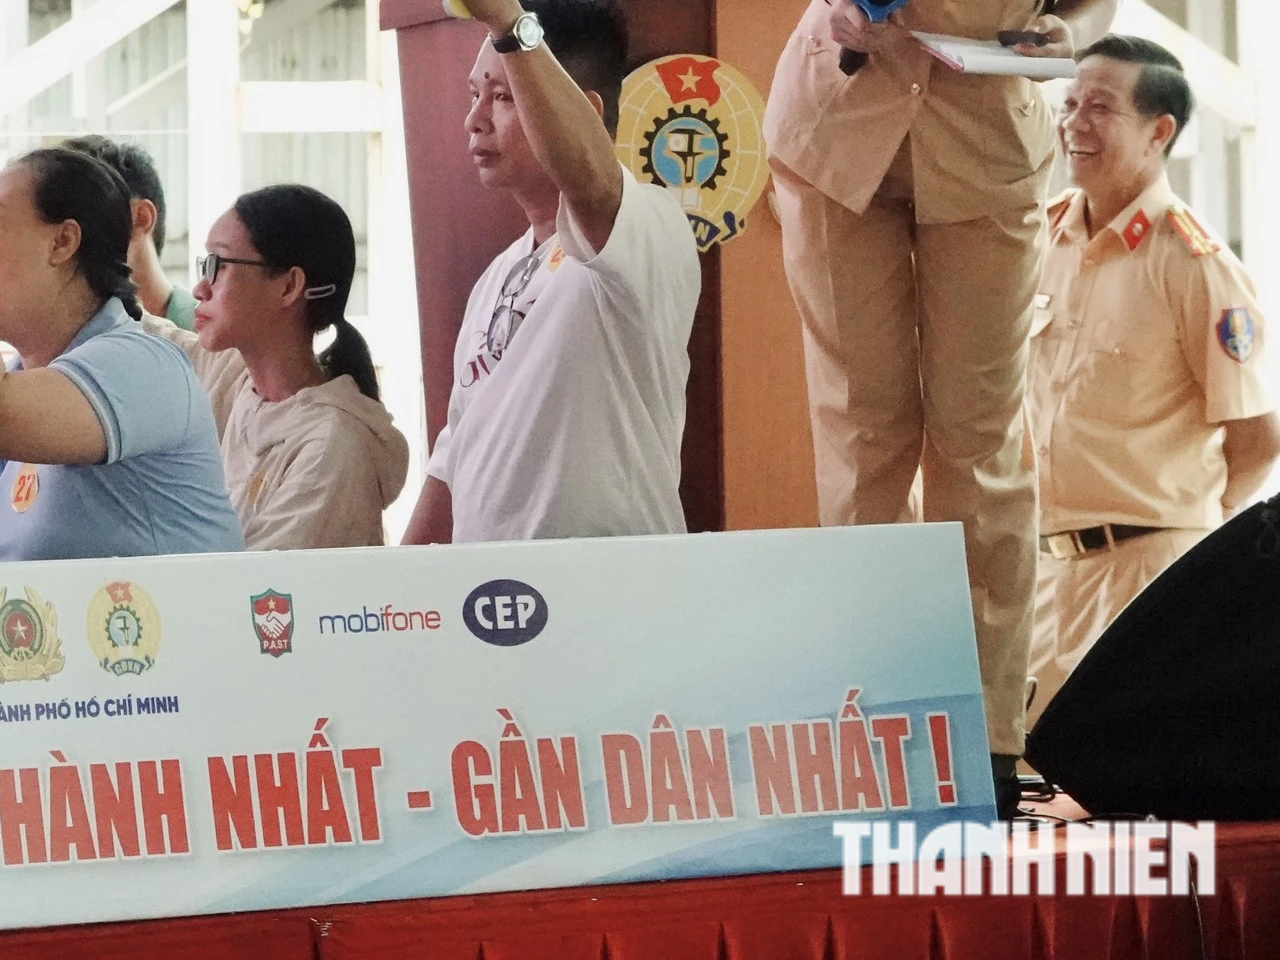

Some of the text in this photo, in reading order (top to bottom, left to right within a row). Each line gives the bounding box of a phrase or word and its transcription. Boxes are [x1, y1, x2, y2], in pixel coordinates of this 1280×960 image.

[14, 474, 36, 503] 27
[318, 604, 441, 634] mobifone
[474, 595, 536, 630] CEP
[34, 697, 72, 720] PHỐ
[104, 693, 133, 717] CHÍ
[136, 695, 180, 715] MINH
[207, 717, 383, 851] NHẤT
[407, 790, 431, 809] -
[451, 708, 586, 837] GẦN
[601, 714, 735, 826] DÂN
[749, 689, 911, 816] NHẤT
[928, 715, 956, 805] !
